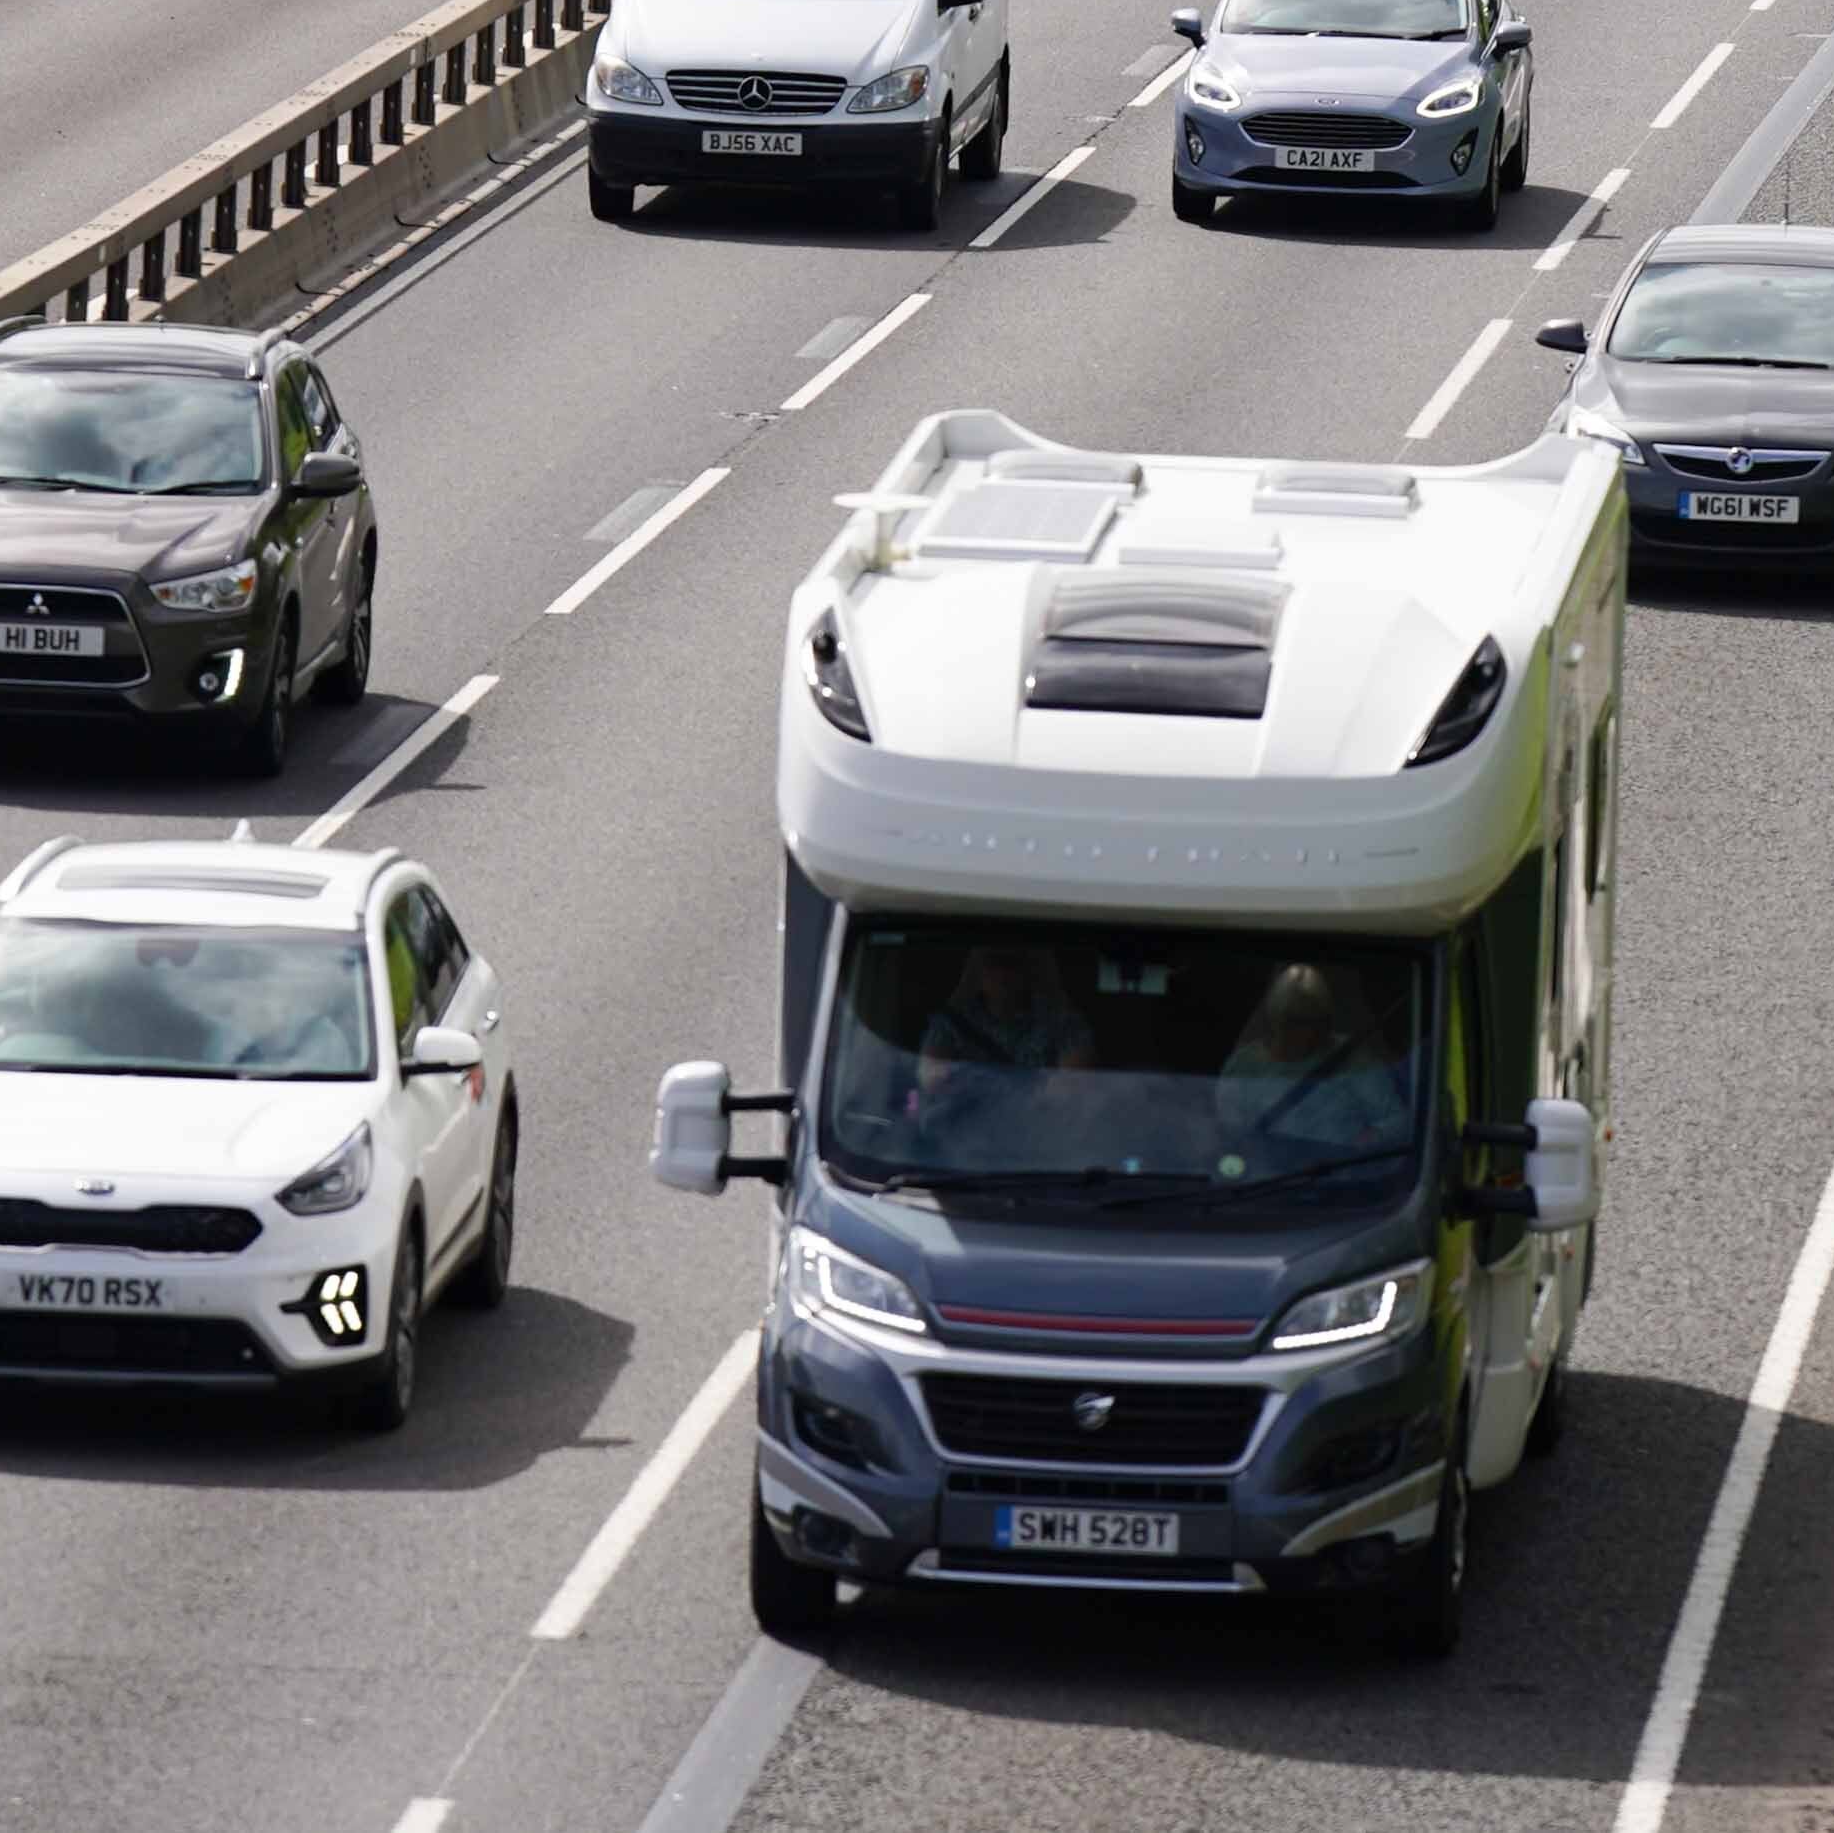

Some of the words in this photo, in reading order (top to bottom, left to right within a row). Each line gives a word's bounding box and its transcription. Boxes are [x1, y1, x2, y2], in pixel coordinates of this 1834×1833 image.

[709, 133, 756, 151] BJ56
[761, 134, 795, 153] XAC
[1286, 149, 1326, 167] CA21
[1329, 151, 1363, 168] AXF
[1696, 497, 1742, 516] WG61
[1748, 499, 1790, 518] WSF
[33, 629, 80, 652] BUH
[19, 1275, 94, 1305] VK70
[103, 1278, 165, 1308] RSX
[1015, 1510, 1080, 1546] SWH
[1089, 1513, 1174, 1549] 528T
